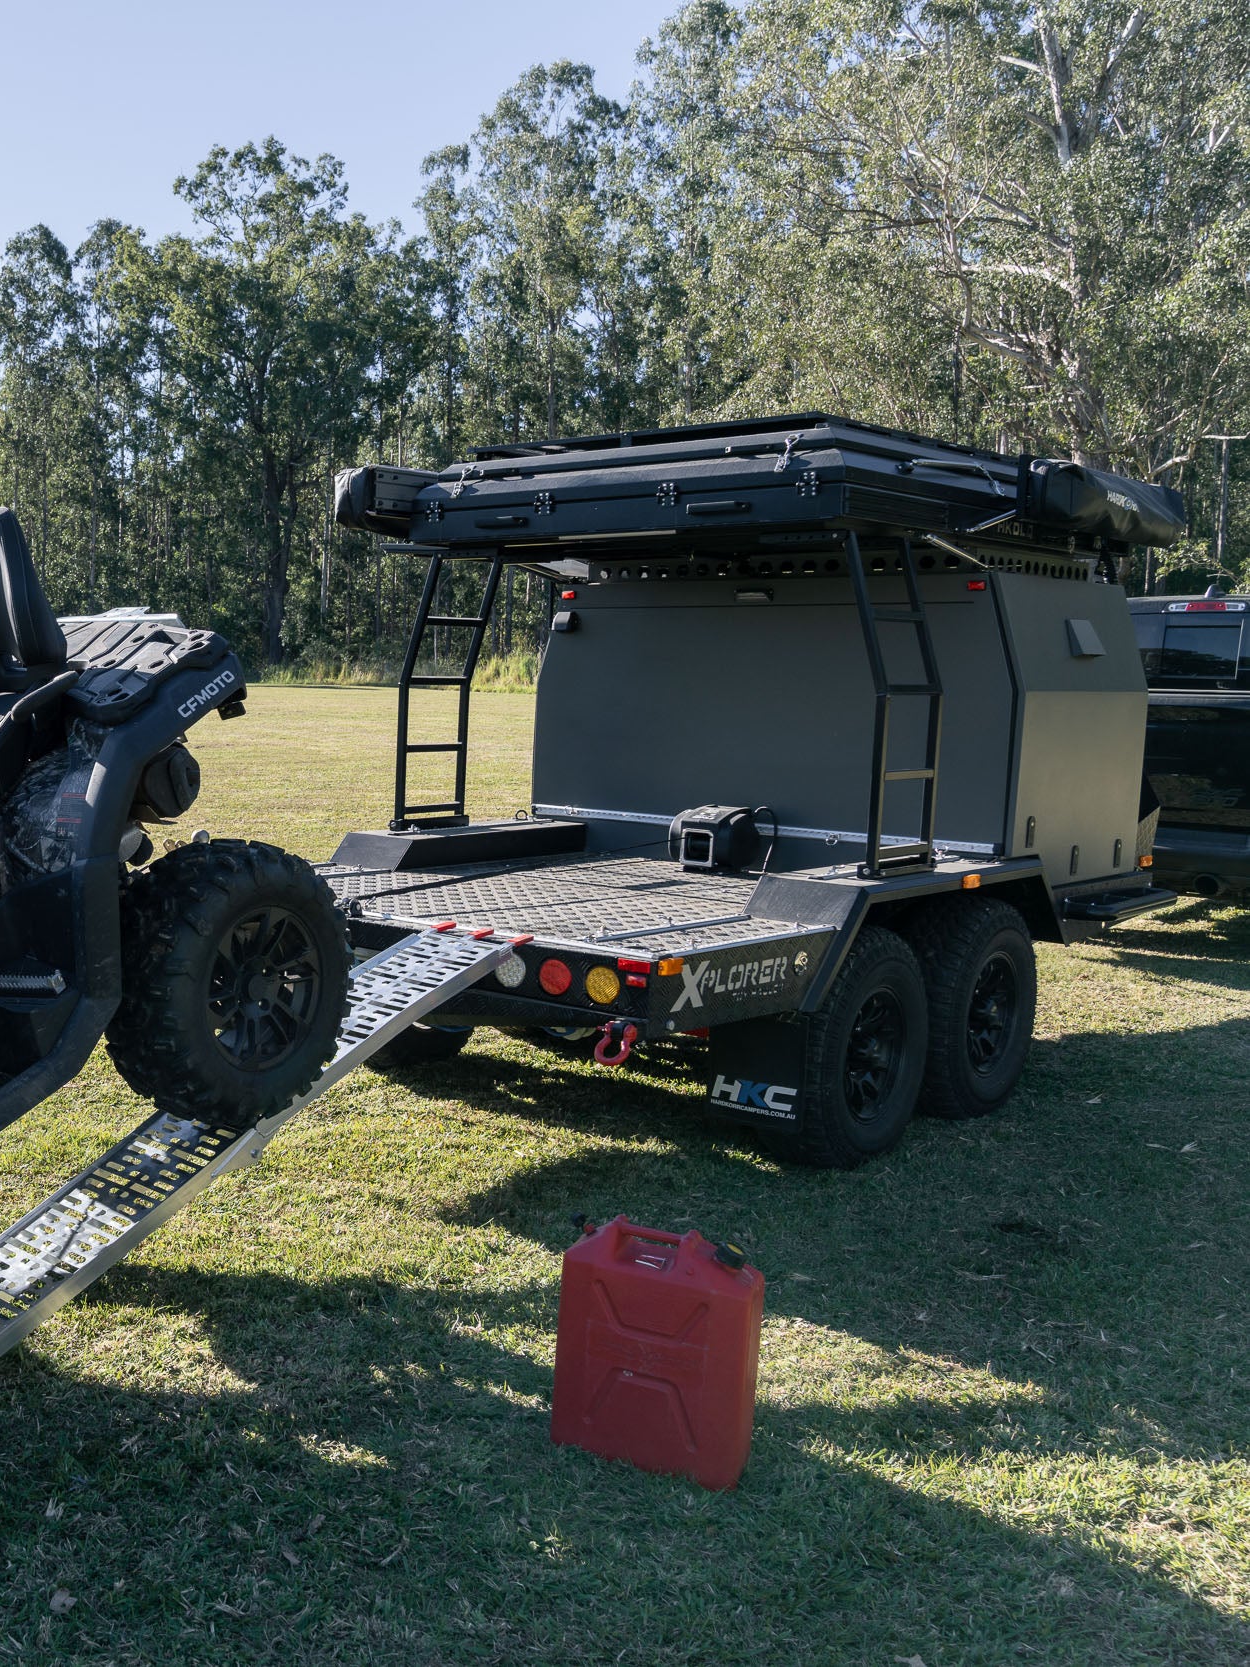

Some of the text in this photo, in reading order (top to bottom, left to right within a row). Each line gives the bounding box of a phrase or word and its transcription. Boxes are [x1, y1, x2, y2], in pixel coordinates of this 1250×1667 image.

[177, 670, 235, 718] CFMOTO
[710, 1098, 797, 1120] HARDKORRCAMPERS.COM.AU
[711, 1074, 798, 1112] HKC
